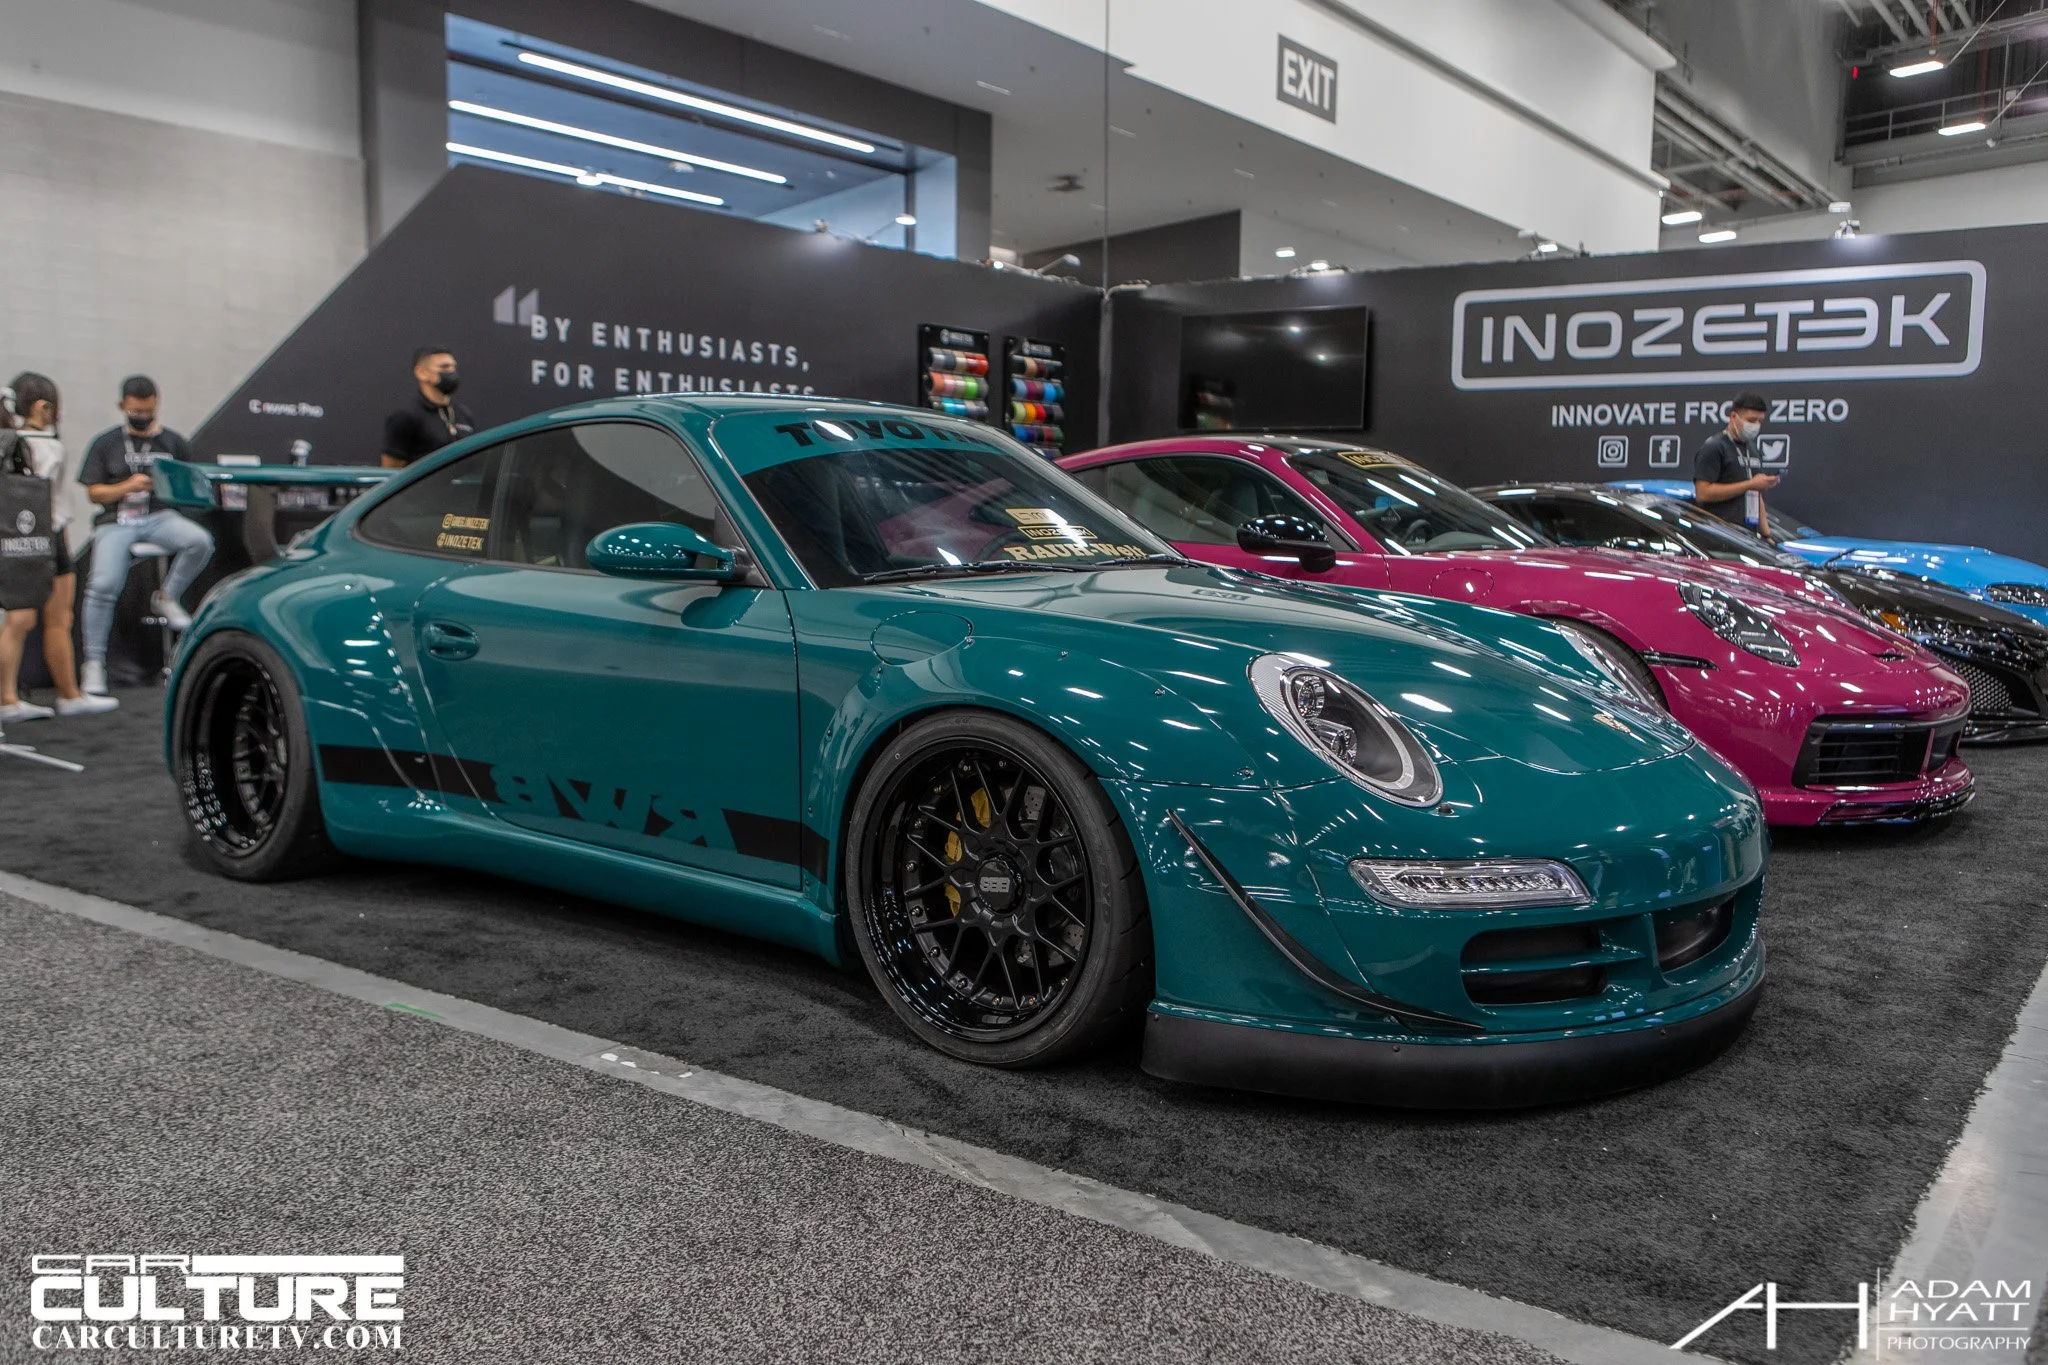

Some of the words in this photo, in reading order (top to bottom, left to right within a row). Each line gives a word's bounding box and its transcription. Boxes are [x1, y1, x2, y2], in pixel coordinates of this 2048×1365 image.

[1282, 46, 1335, 112] EXIT
[530, 314, 572, 343] BY
[591, 321, 810, 373] ENTHUSIASTS,
[1480, 292, 1952, 364] INOZETEK
[531, 359, 594, 390] FOR
[775, 419, 925, 447] TOYO
[1551, 402, 1676, 428] INNOVATE
[1684, 400, 1734, 425] FRO
[1769, 398, 1849, 424] ZERO
